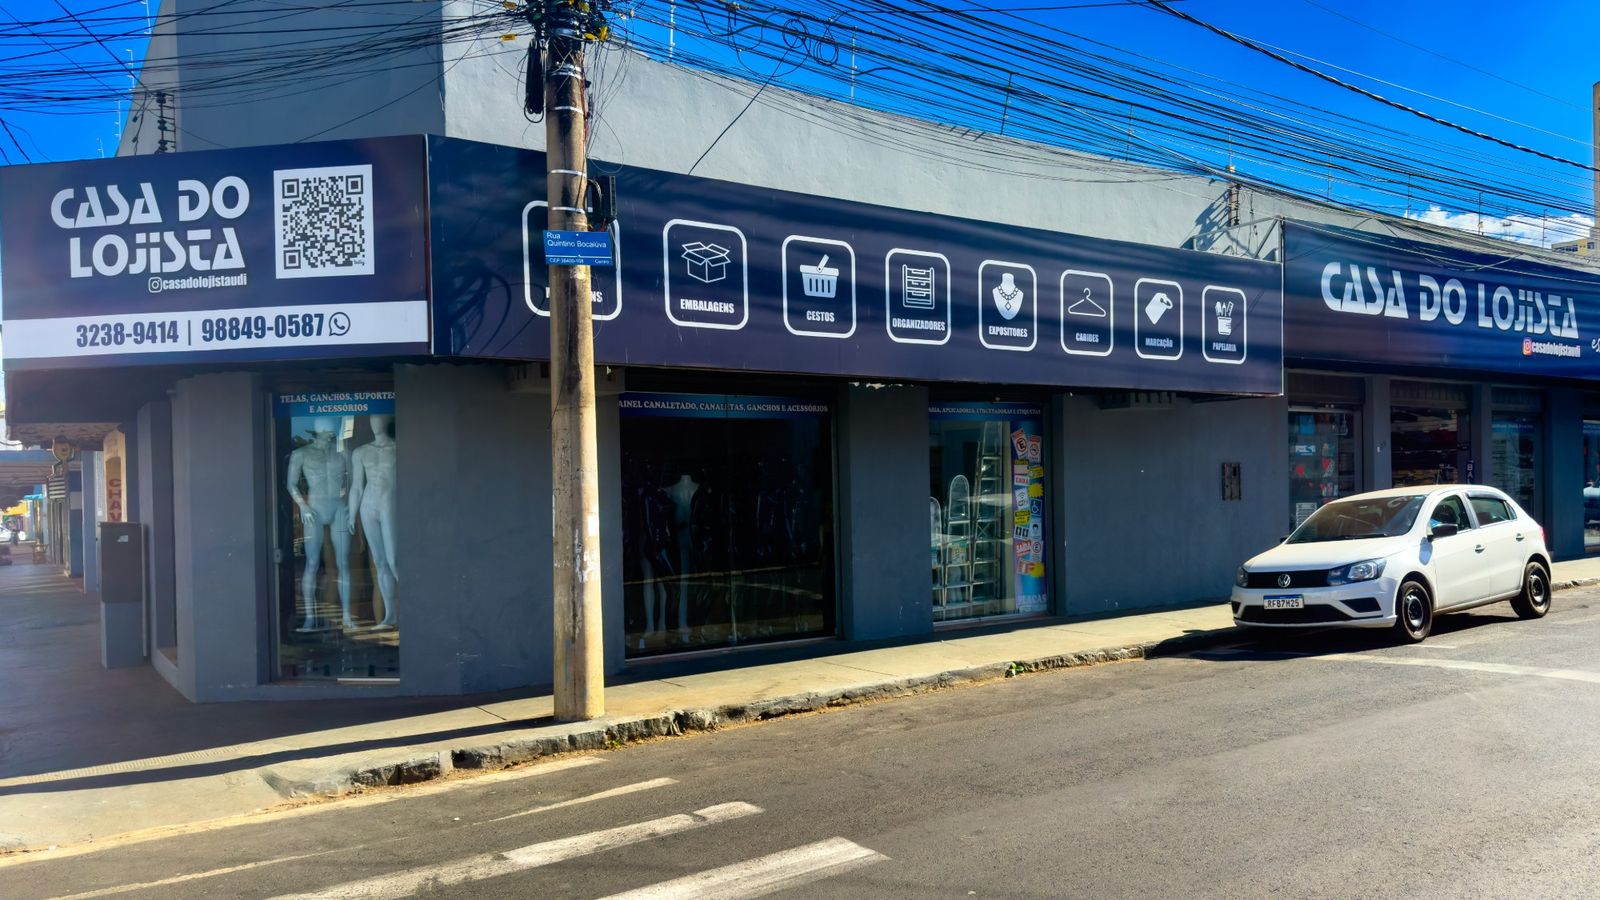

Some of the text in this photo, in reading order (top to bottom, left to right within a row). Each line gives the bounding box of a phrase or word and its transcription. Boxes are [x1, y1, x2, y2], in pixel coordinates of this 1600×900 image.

[51, 176, 250, 229] CASA DO
[547, 240, 576, 248] Quintino
[163, 274, 247, 291] casadolojistaudi
[1321, 262, 1409, 319] CASA
[1419, 274, 1467, 325] DO
[680, 298, 735, 314] EMBALAGENS
[806, 310, 835, 322] CESTOS
[76, 313, 325, 348] 3238-9414 98849-0587
[892, 317, 946, 331] ORGANIZADORES
[988, 325, 1028, 338] EXPOSITORES
[1145, 336, 1173, 349] MARCAÇÃO
[1212, 342, 1237, 352] PAPELARIA
[1531, 340, 1580, 358] casadolojistaudi
[280, 394, 309, 404] TELAS,
[310, 393, 352, 402] GANCHOS,
[309, 403, 369, 413] E ACESSÓRIOS
[643, 401, 699, 411] CANALETADO,
[747, 404, 780, 412] GANCHOS
